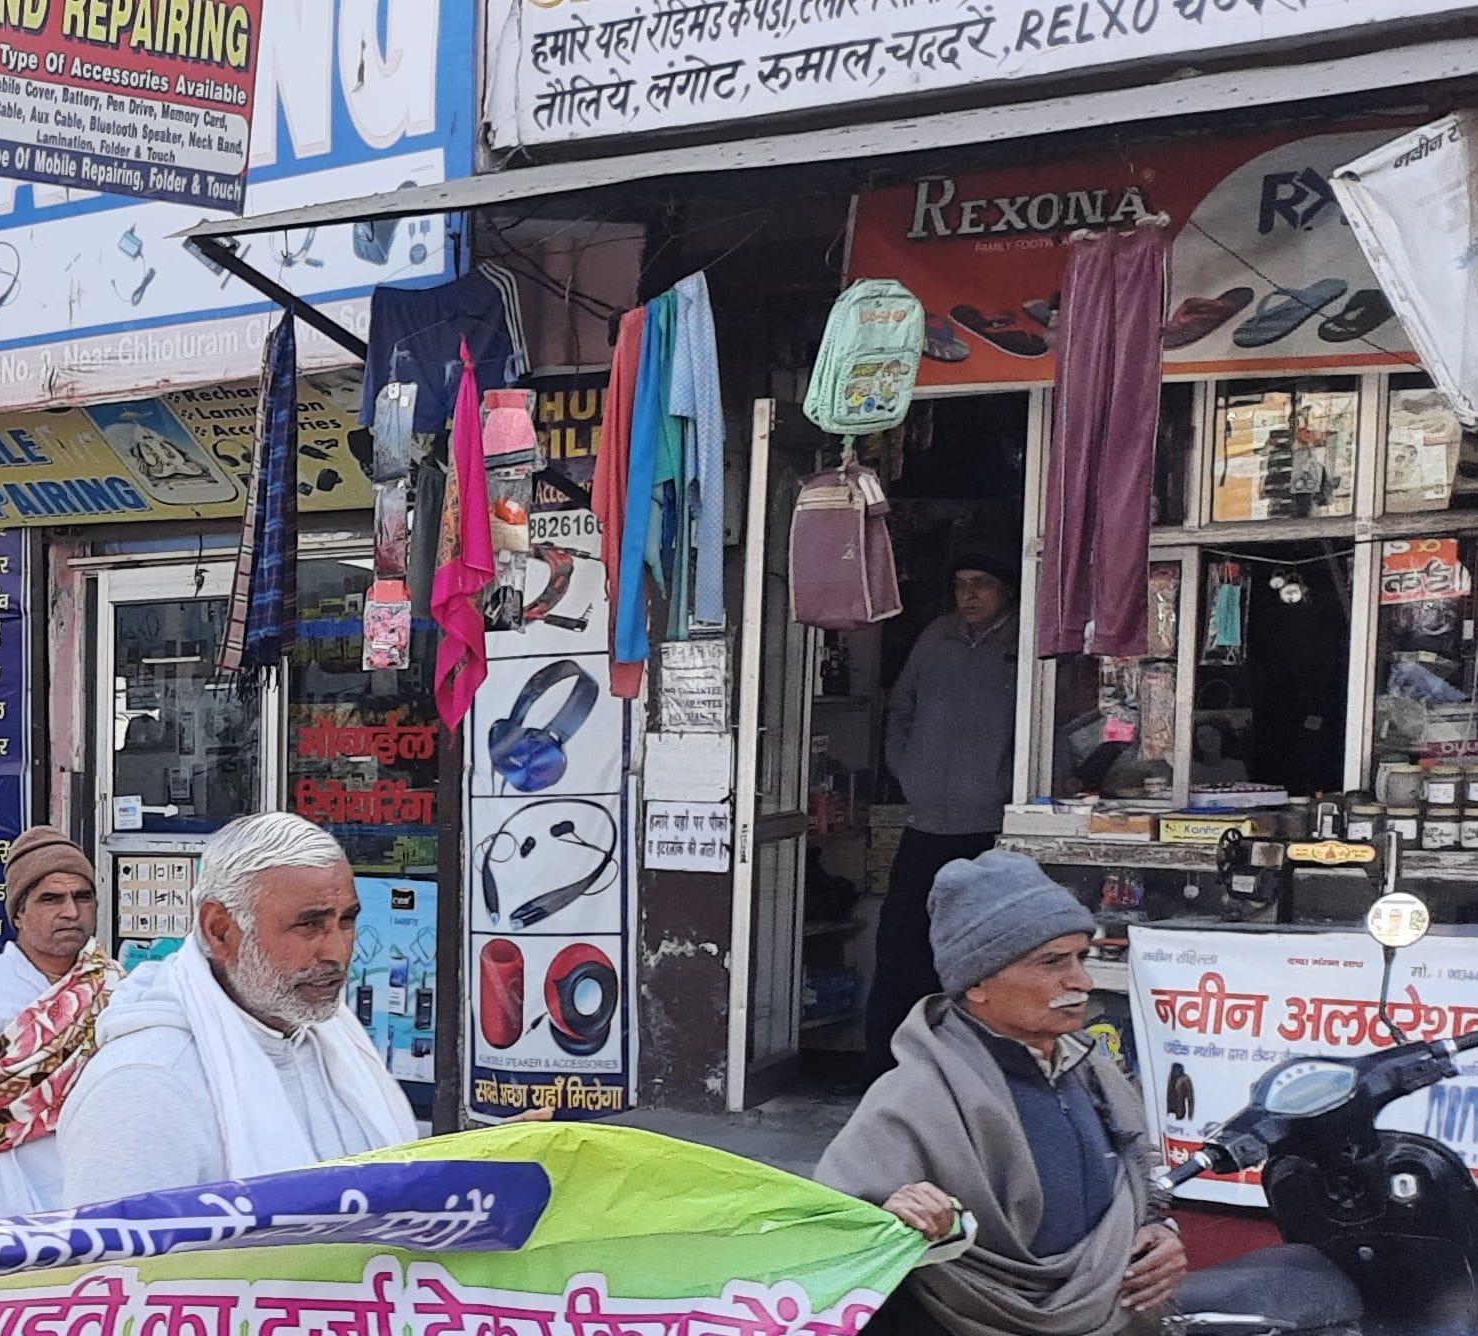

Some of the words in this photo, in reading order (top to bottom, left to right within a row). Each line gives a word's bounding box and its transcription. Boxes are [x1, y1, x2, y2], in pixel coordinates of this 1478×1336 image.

[62, 0, 251, 68] REPAIRING
[530, 13, 593, 74] हमारे
[0, 43, 39, 73] Type
[45, 53, 65, 74] Of
[175, 75, 247, 107] Available
[645, 55, 751, 112] लंगोट,
[25, 79, 58, 103] Cover,
[61, 88, 103, 112] Battery,
[106, 95, 126, 112] Pen
[128, 99, 158, 120] Drive,
[161, 102, 200, 125] Memory
[203, 111, 228, 131] Card,
[30, 107, 50, 124] Aux
[54, 113, 86, 134] Cable,
[89, 115, 138, 139] Bluetooth
[142, 124, 185, 147] Speaker,
[188, 132, 214, 151] Neck
[216, 138, 244, 157] Band,
[36, 129, 96, 153] Lamination,
[99, 140, 131, 157] Folder
[135, 145, 142, 159] &
[146, 146, 176, 163] Touch
[14, 147, 31, 168] Of
[34, 150, 77, 177] Mobile
[81, 157, 144, 191] Repairing,
[148, 167, 187, 192] Folder
[191, 174, 201, 195] &
[206, 176, 242, 201] Touch
[907, 176, 1147, 241] REXONA
[0, 354, 34, 384] No.
[183, 385, 260, 403] Rechar
[1150, 971, 1269, 1038] नवीन
[567, 1076, 623, 1111] मिलेगा
